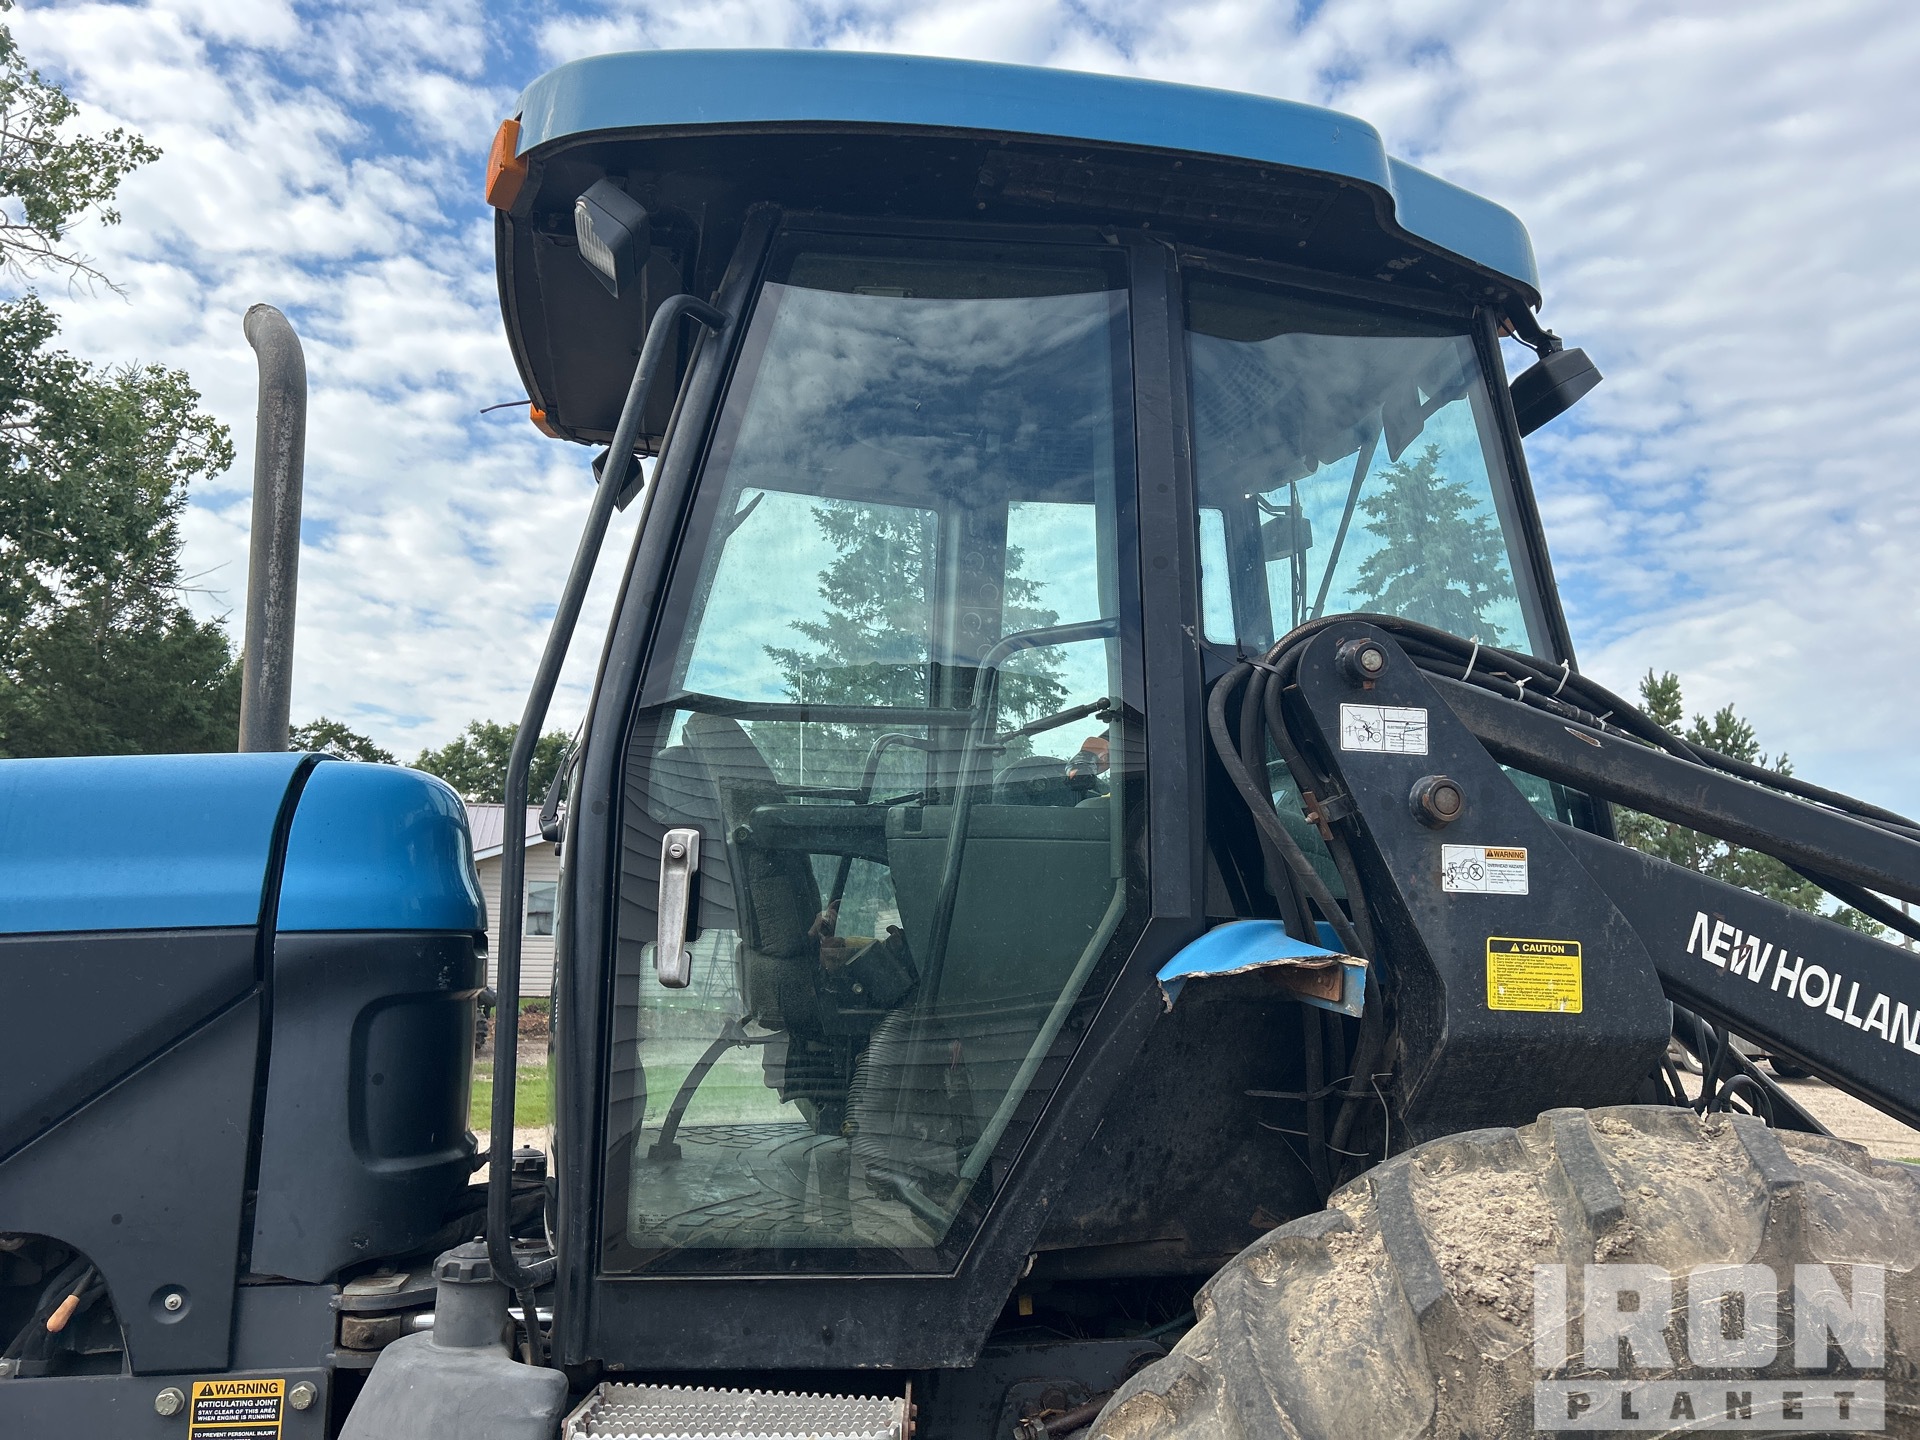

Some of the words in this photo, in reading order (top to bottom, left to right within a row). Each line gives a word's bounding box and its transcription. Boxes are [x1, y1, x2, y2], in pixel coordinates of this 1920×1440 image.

[1493, 851, 1525, 859] WARNING
[1522, 943, 1565, 954] CAUTION
[1686, 910, 1774, 983] NEW
[1770, 948, 1920, 1056] HOLLAN
[216, 1382, 278, 1395] WARNING
[197, 1399, 254, 1408] ARTICULATING
[254, 1398, 278, 1407] JOINT
